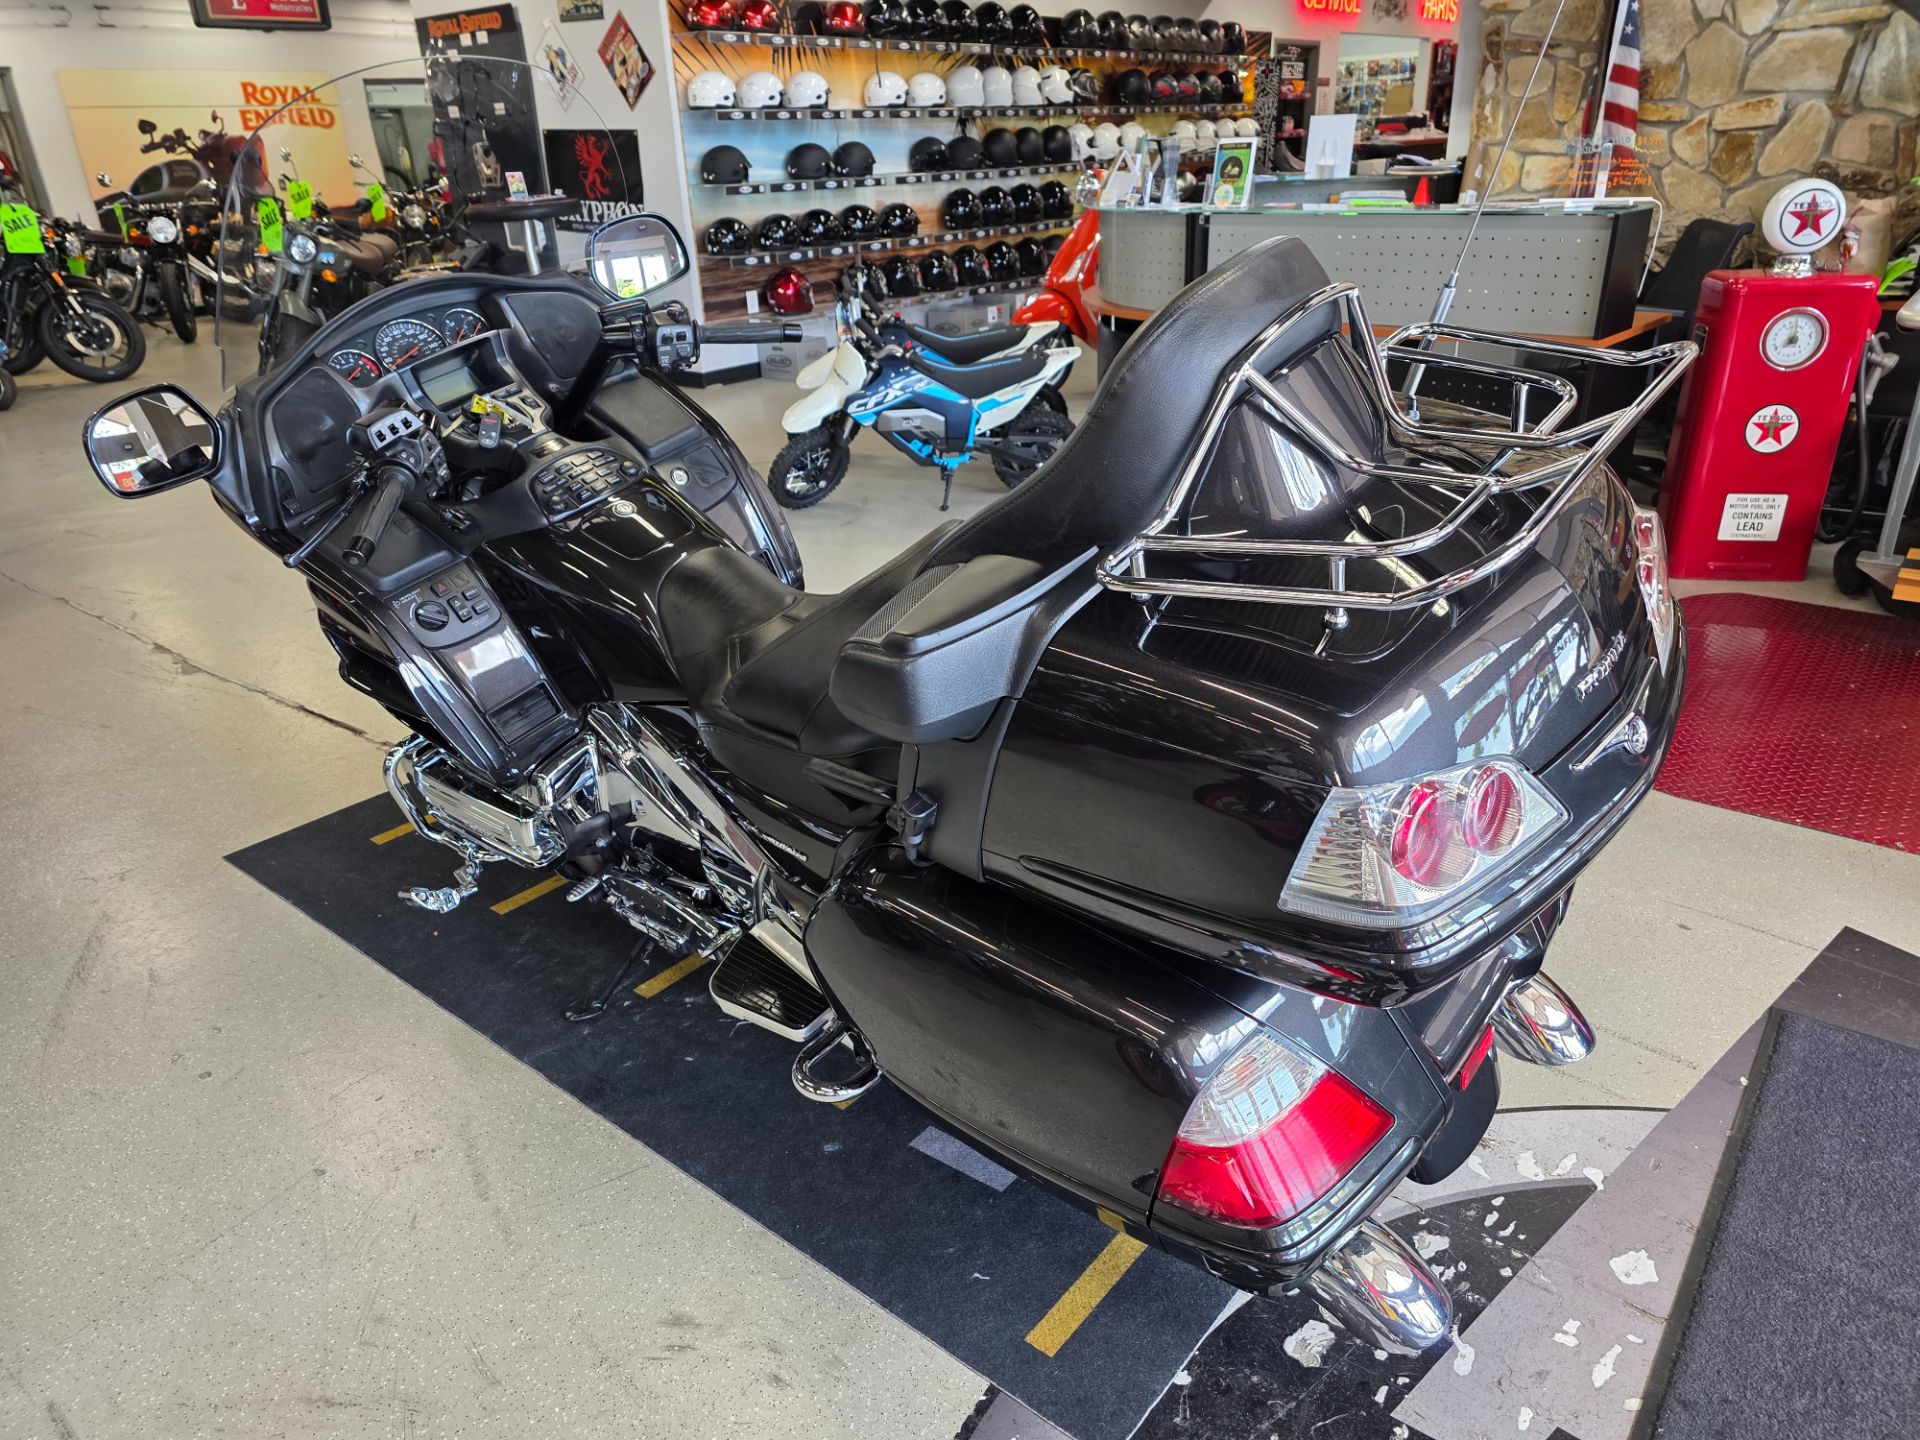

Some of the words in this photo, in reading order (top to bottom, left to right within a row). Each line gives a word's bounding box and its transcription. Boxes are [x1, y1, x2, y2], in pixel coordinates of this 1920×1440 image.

[1423, 0, 1457, 21] PARTS
[427, 18, 461, 37] ROYAL
[240, 82, 321, 106] ROYAL
[239, 107, 335, 131] ENFIELD
[559, 200, 644, 223] YPHON
[1794, 201, 1833, 210] TEXACO
[4, 214, 34, 233] SALE
[1732, 511, 1774, 520] CONTAINS
[1736, 521, 1764, 531] LEAD
